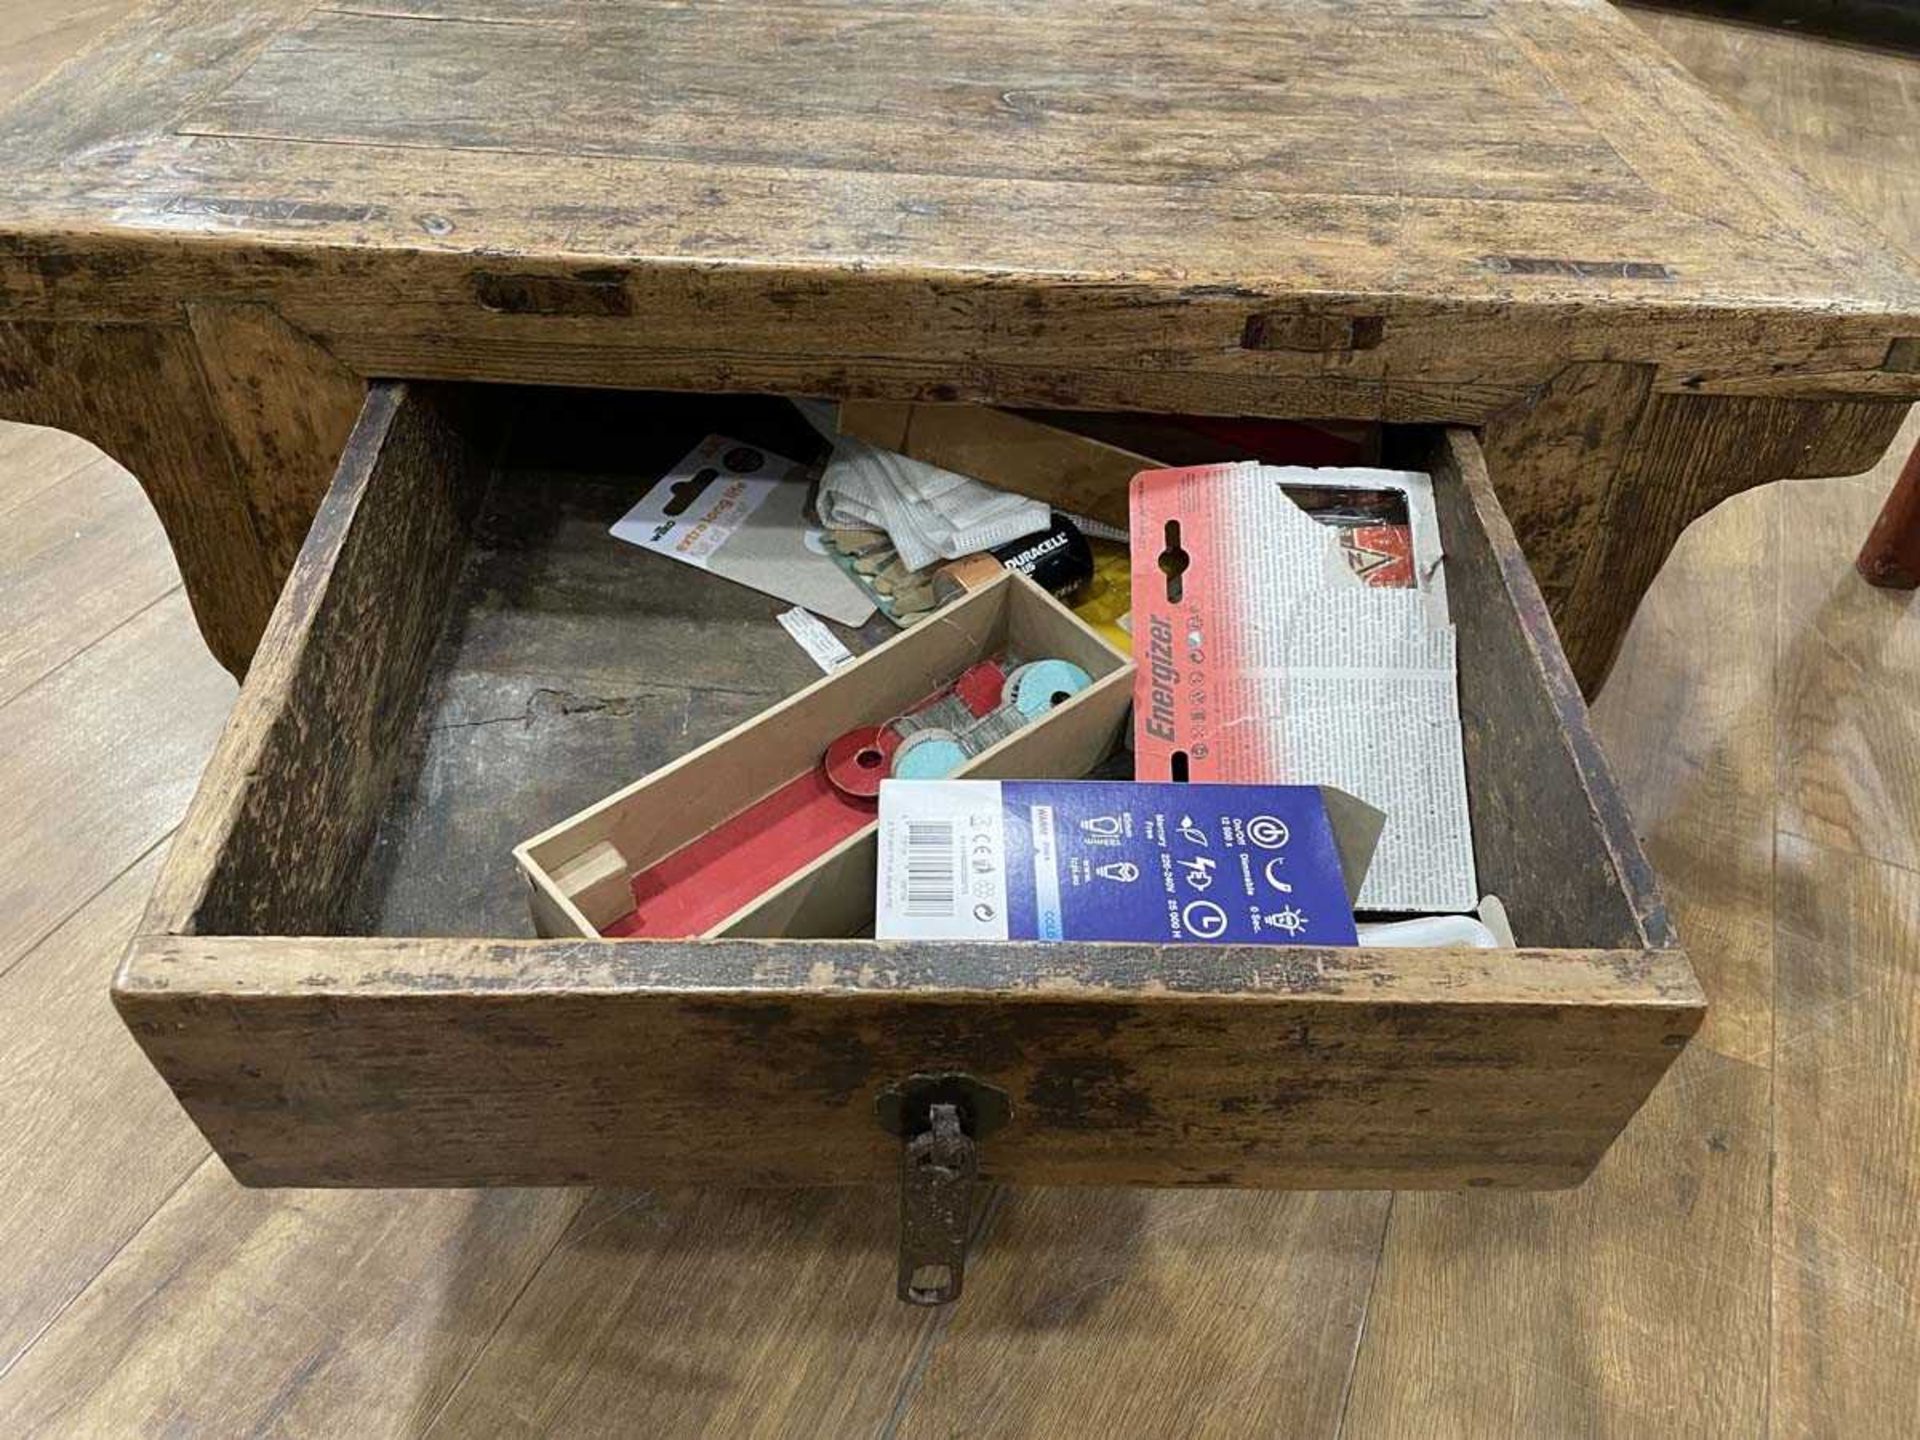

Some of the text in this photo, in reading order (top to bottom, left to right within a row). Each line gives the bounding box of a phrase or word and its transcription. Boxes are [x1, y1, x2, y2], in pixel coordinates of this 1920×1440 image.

[1004, 534, 1069, 570] DURACELL
[1145, 614, 1181, 743] Energizer
[1233, 818, 1246, 846] On/Off
[1240, 853, 1255, 896] Dimmable
